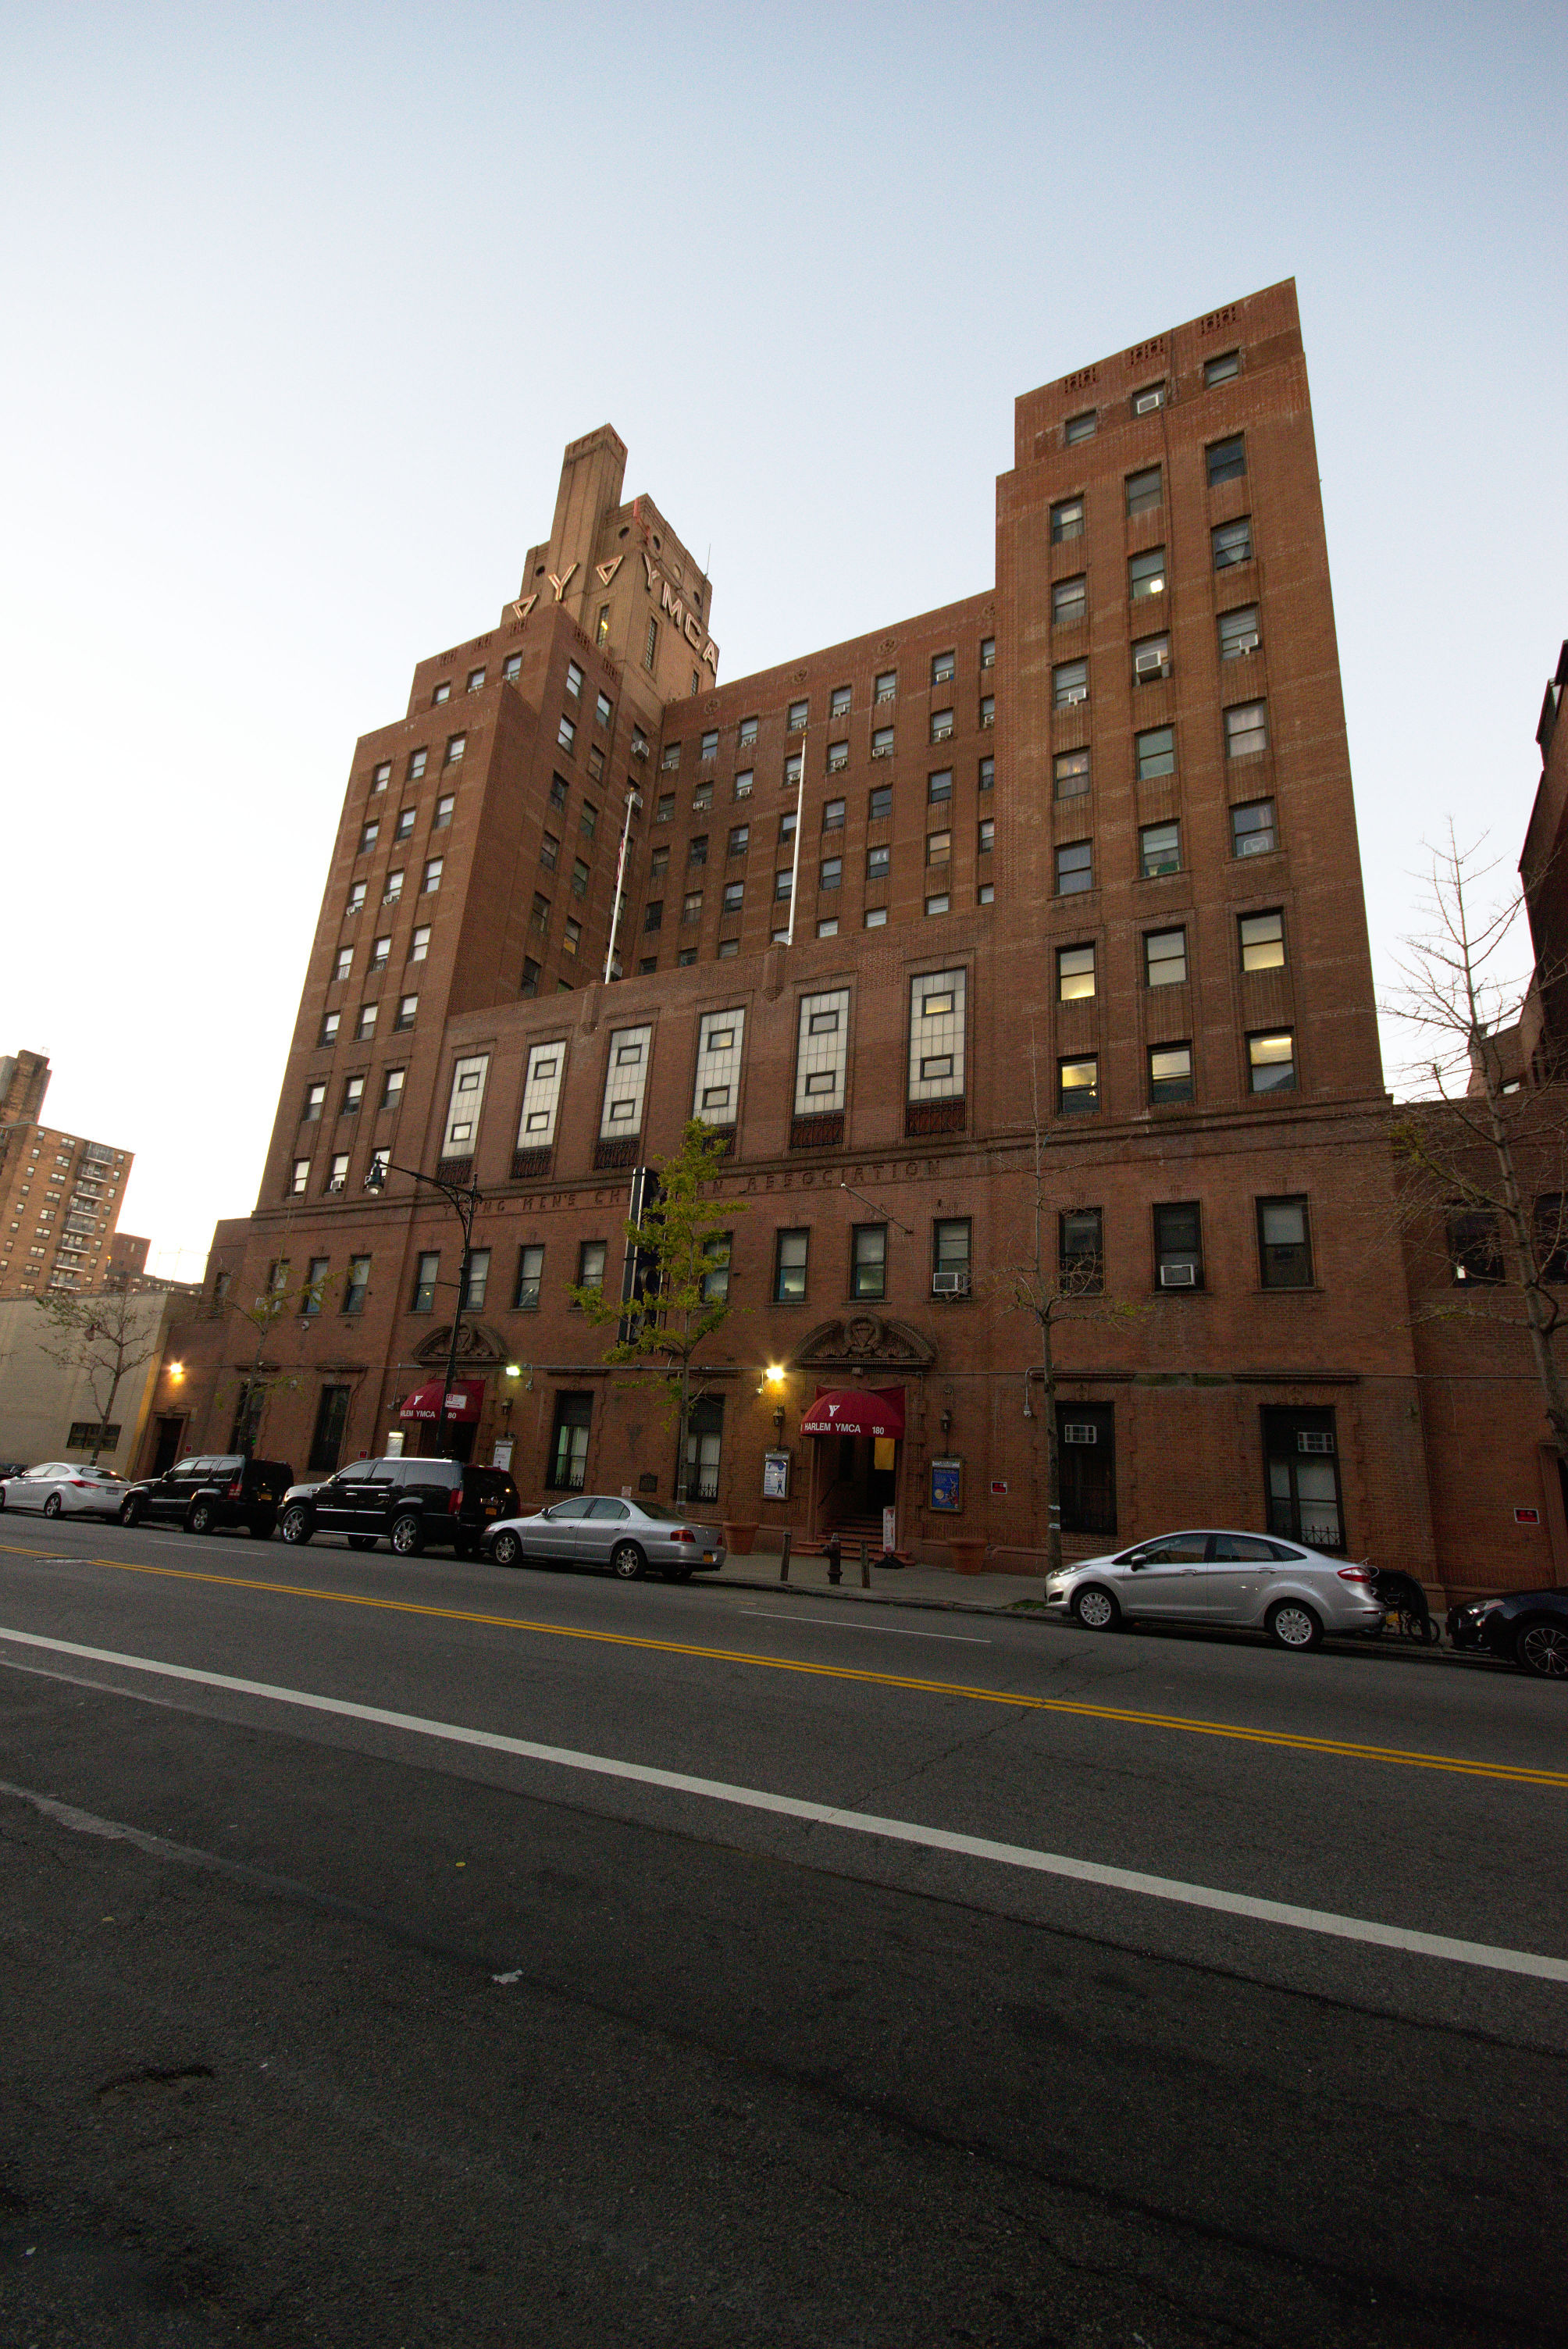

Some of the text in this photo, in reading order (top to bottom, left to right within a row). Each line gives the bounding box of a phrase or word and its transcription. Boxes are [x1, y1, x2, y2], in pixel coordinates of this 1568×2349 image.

[548, 562, 579, 601] Y
[642, 552, 716, 674] YMCA
[523, 1194, 576, 1210] MEN'S
[747, 1160, 939, 1190] ASSOCIATION
[804, 1422, 831, 1431] HARLEM
[835, 1423, 861, 1433] YMCA
[872, 1426, 884, 1435] 180
